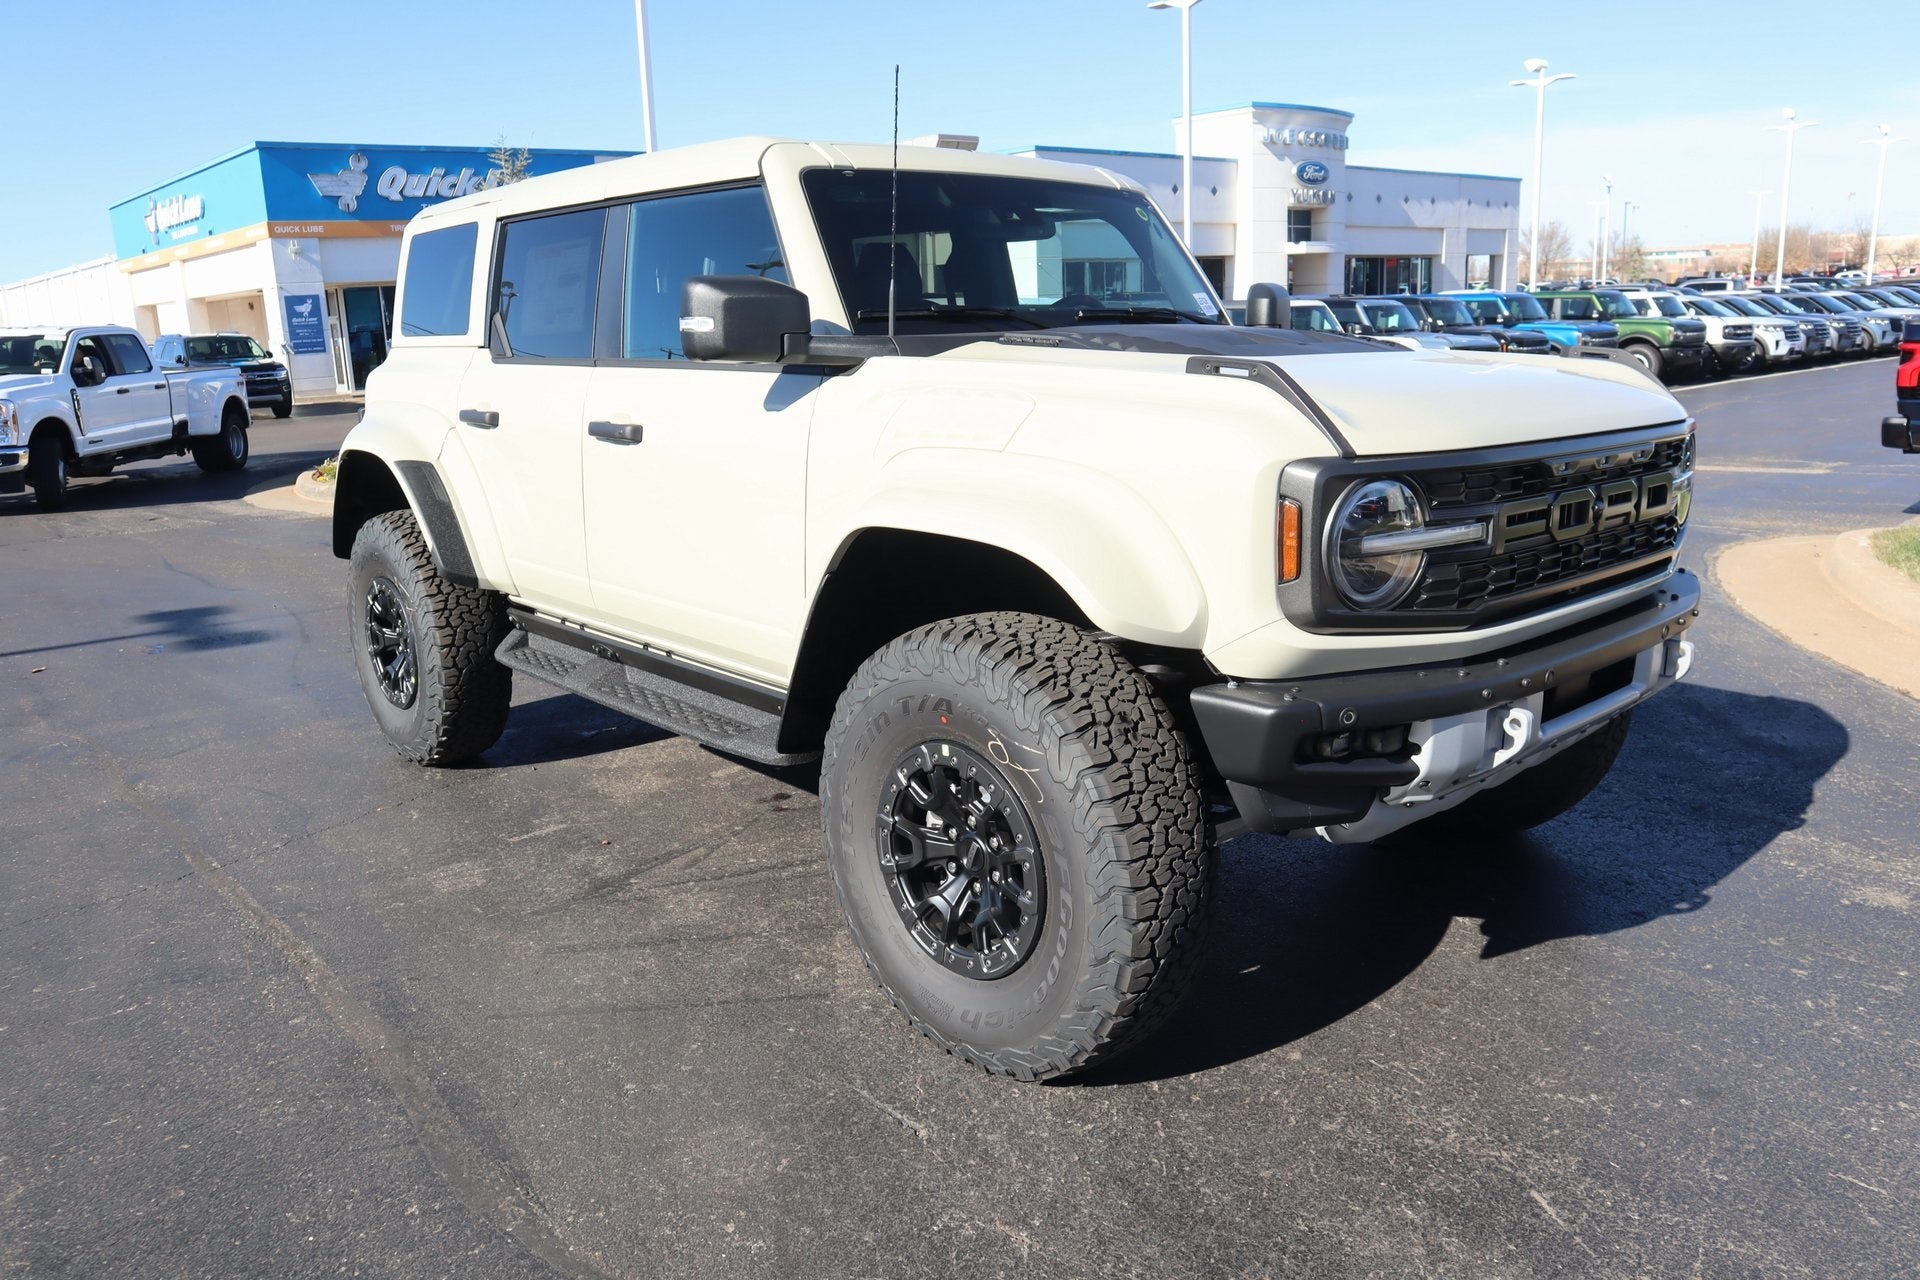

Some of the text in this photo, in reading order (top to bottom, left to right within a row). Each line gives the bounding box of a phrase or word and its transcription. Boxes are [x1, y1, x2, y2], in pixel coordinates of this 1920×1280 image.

[1263, 127, 1295, 144] JOE
[1303, 164, 1325, 180] Ford
[377, 165, 482, 202] Quick
[1289, 188, 1336, 204] YUKON
[274, 225, 300, 233] QUICK
[1495, 470, 1674, 555] FORD
